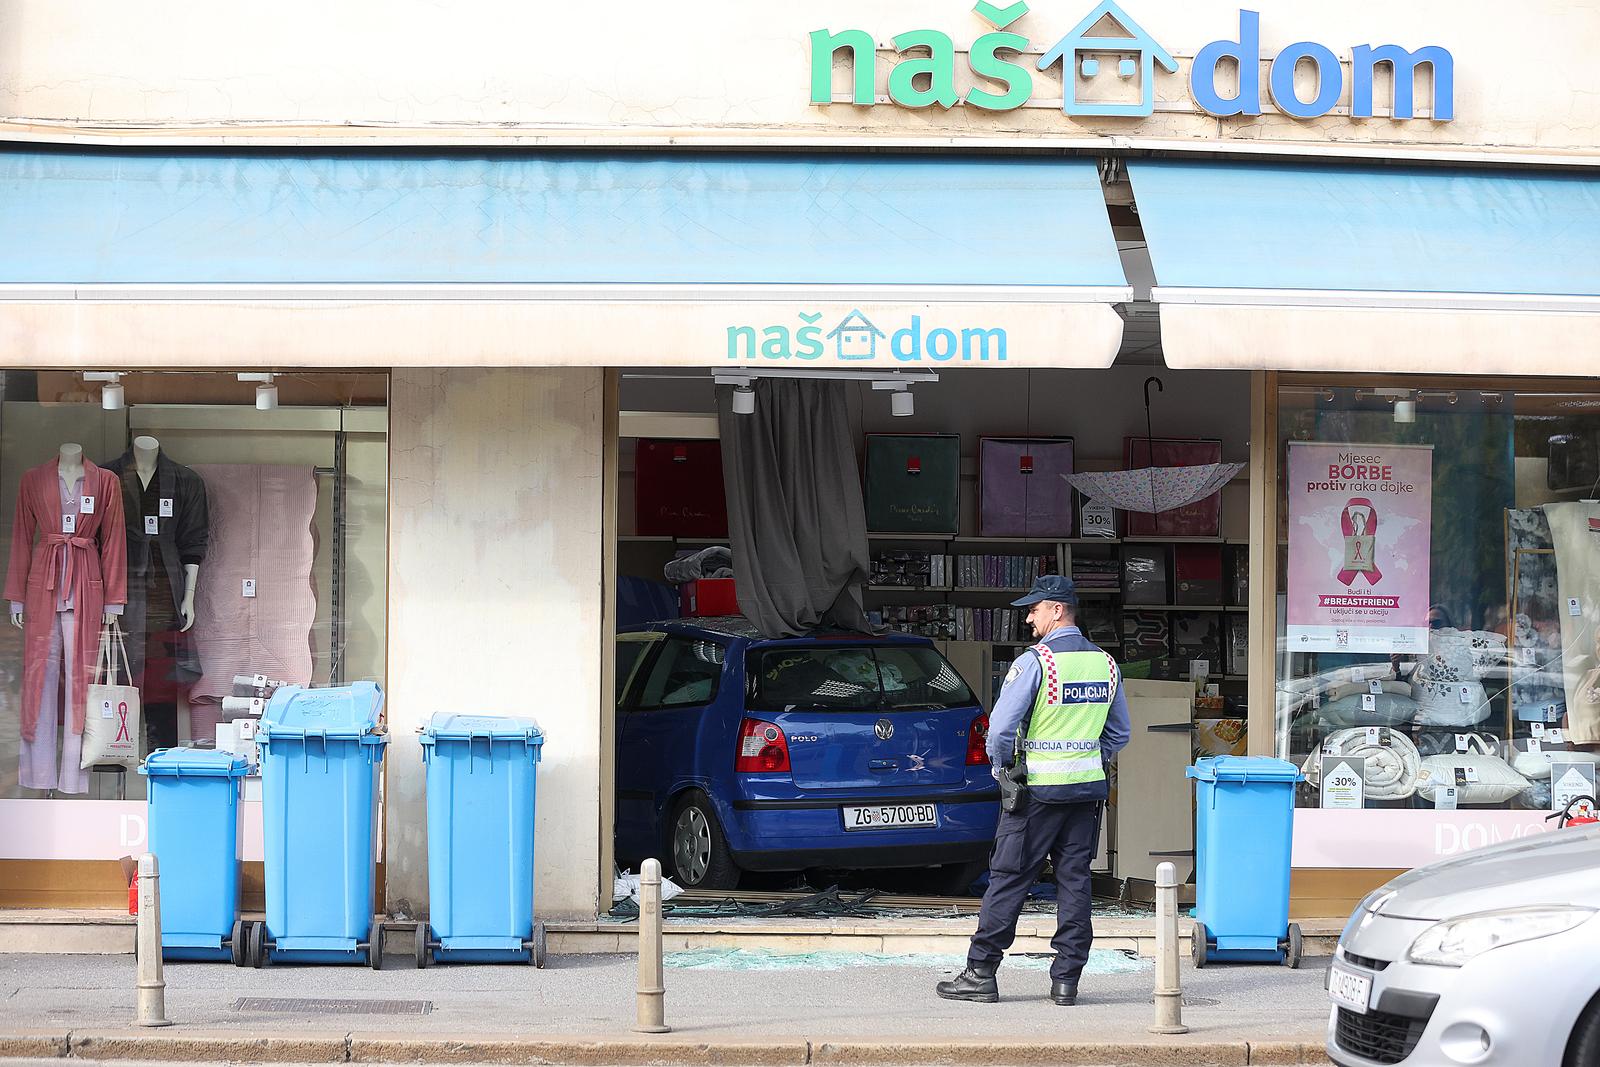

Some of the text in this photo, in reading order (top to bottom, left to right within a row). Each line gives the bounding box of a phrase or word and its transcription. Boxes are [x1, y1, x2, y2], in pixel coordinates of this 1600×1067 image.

[809, 0, 1454, 122] naš dom
[727, 311, 1008, 362] naš dom
[1338, 453, 1381, 465] Mjesec
[1328, 464, 1392, 480] BORBE
[1307, 480, 1414, 494] protiv raka dojke
[1084, 514, 1110, 525] -30%
[1323, 597, 1395, 606] #BREASTFRIEND
[1369, 609, 1389, 617] akciju
[1064, 686, 1108, 699] POLICIJA
[1023, 741, 1062, 750] POLICIJA
[1331, 777, 1357, 787] -30%
[854, 808, 872, 825] ZG
